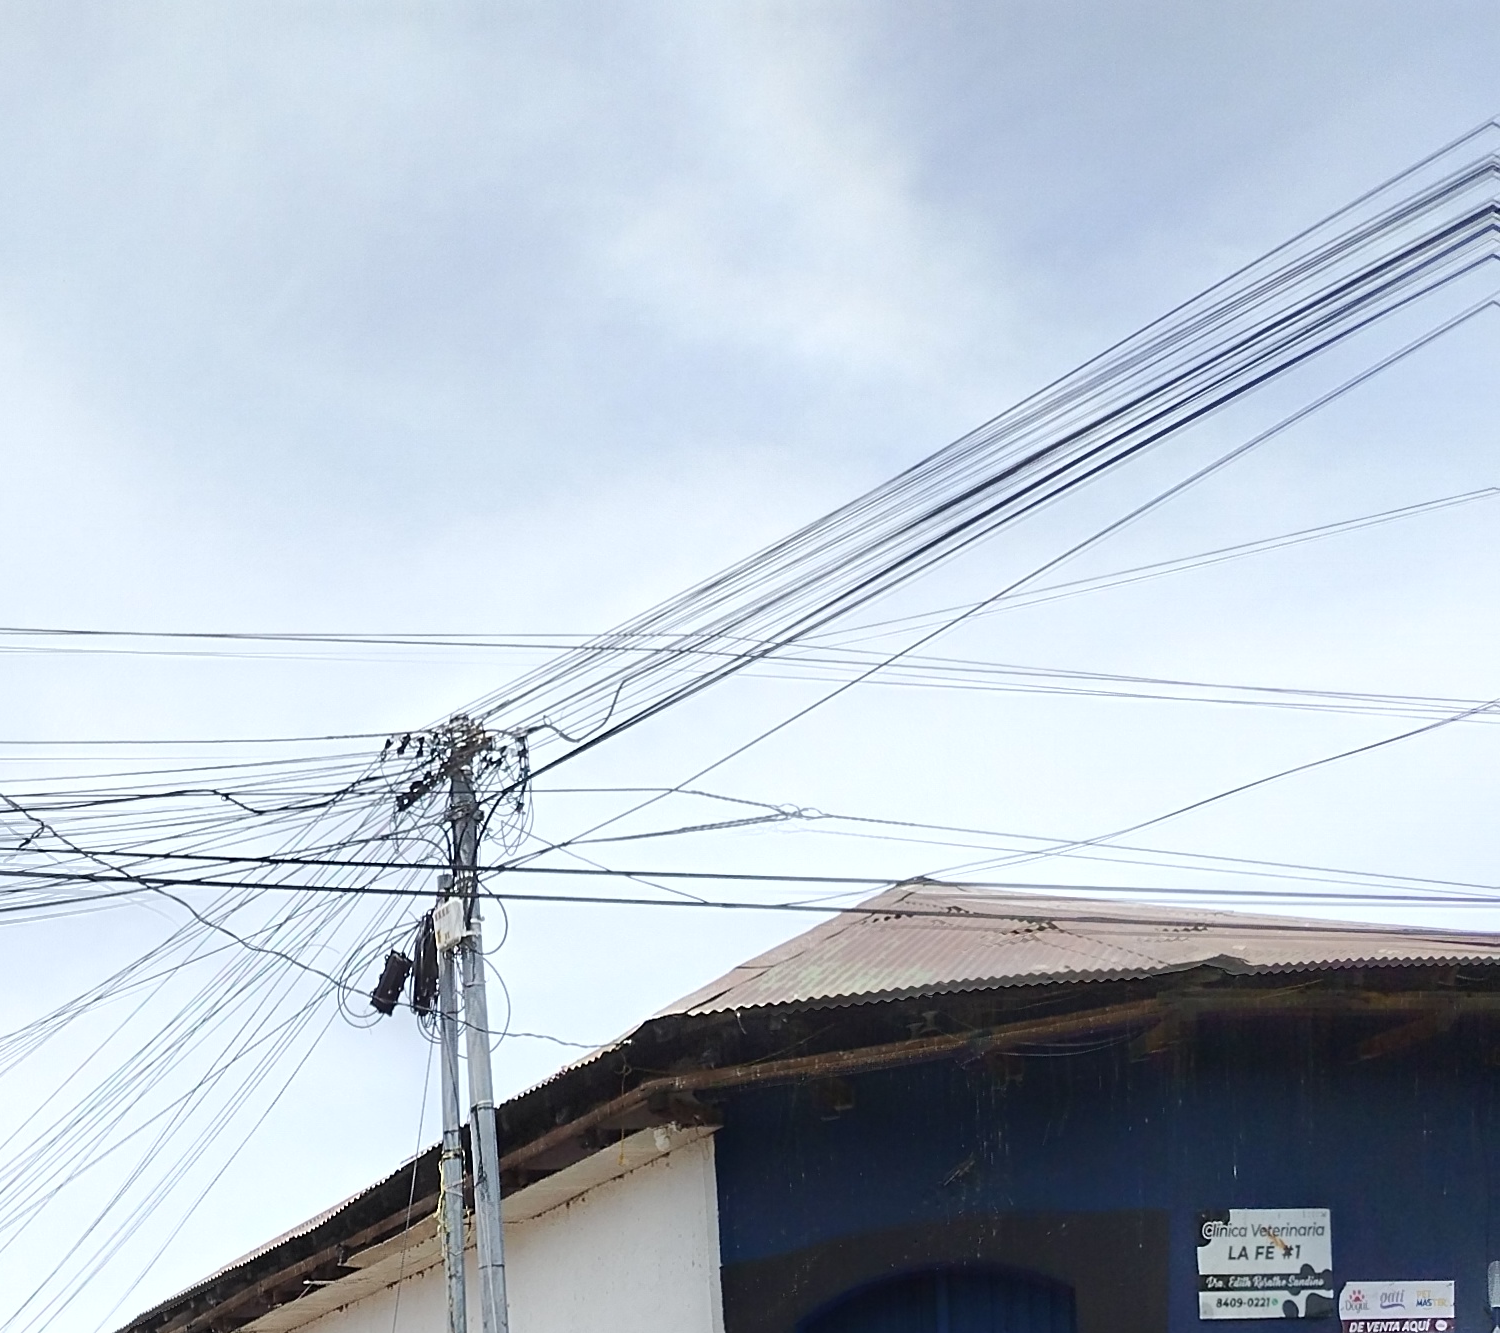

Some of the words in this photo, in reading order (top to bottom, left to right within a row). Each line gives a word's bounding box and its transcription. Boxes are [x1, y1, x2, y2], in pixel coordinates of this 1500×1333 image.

[1251, 1222, 1325, 1237] Veterinaria
[1228, 1246, 1249, 1260] LA
[1255, 1242, 1275, 1260] FÉ
[1282, 1245, 1301, 1259] #1
[1216, 1297, 1270, 1308] 8409-0221
[1349, 1321, 1363, 1333] DE
[1366, 1321, 1400, 1333] VENTA
[1402, 1318, 1431, 1333] AQUÍ
